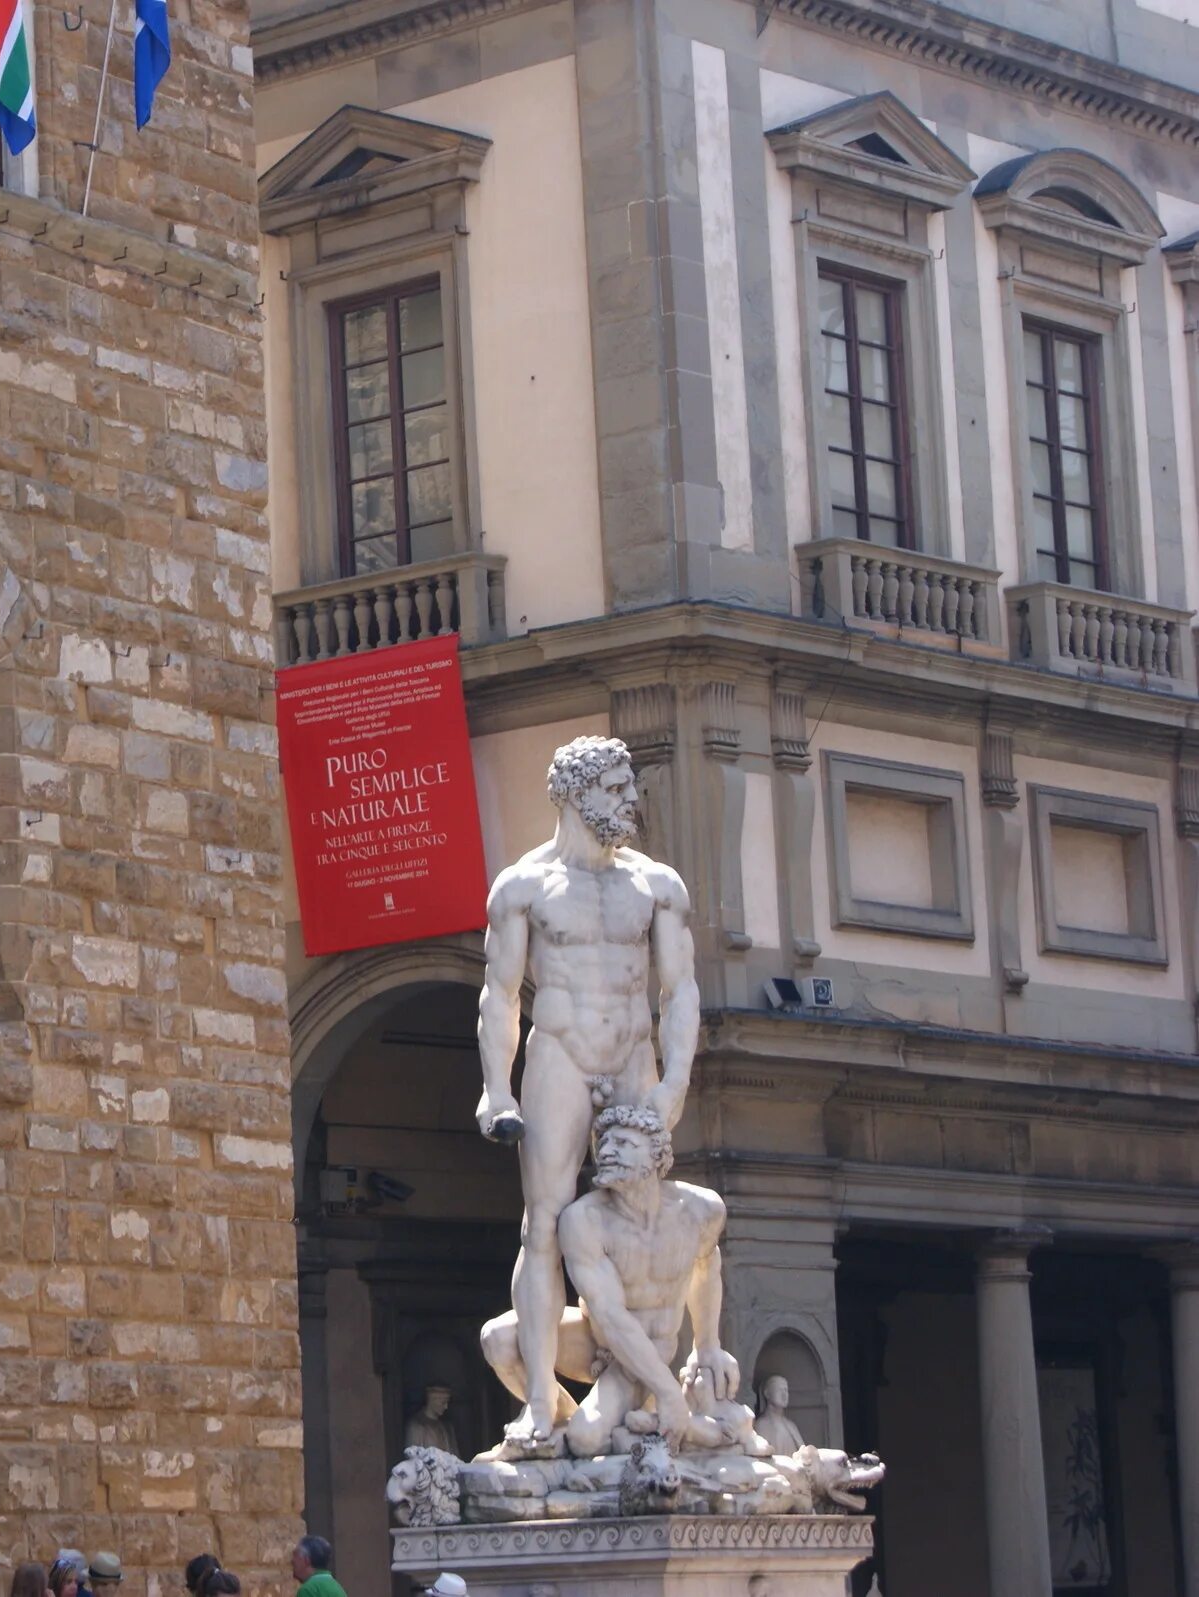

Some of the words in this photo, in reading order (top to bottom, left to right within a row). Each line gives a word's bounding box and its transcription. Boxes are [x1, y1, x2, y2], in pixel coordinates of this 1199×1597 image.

[280, 688, 310, 700] MINISTERO
[310, 686, 322, 694] PER
[326, 682, 338, 691] BENI
[377, 668, 408, 680] CULTURALI
[414, 664, 425, 673] DEL
[426, 659, 453, 670] TURISMO
[326, 748, 387, 788] PURO
[350, 762, 450, 799] SEMPLICE
[310, 812, 318, 825] E
[321, 792, 430, 830] NATURALE
[316, 853, 337, 866] TRA
[339, 844, 380, 860] CINQUE
[383, 843, 390, 854] E
[392, 832, 448, 852] SEICENTO
[325, 830, 375, 849] NELL'ARTE
[377, 829, 385, 840] A
[387, 820, 432, 838] FIRENZE
[354, 878, 376, 888] GIUGNO
[384, 871, 415, 883] NOVEMBRE
[416, 869, 429, 878] 2014
